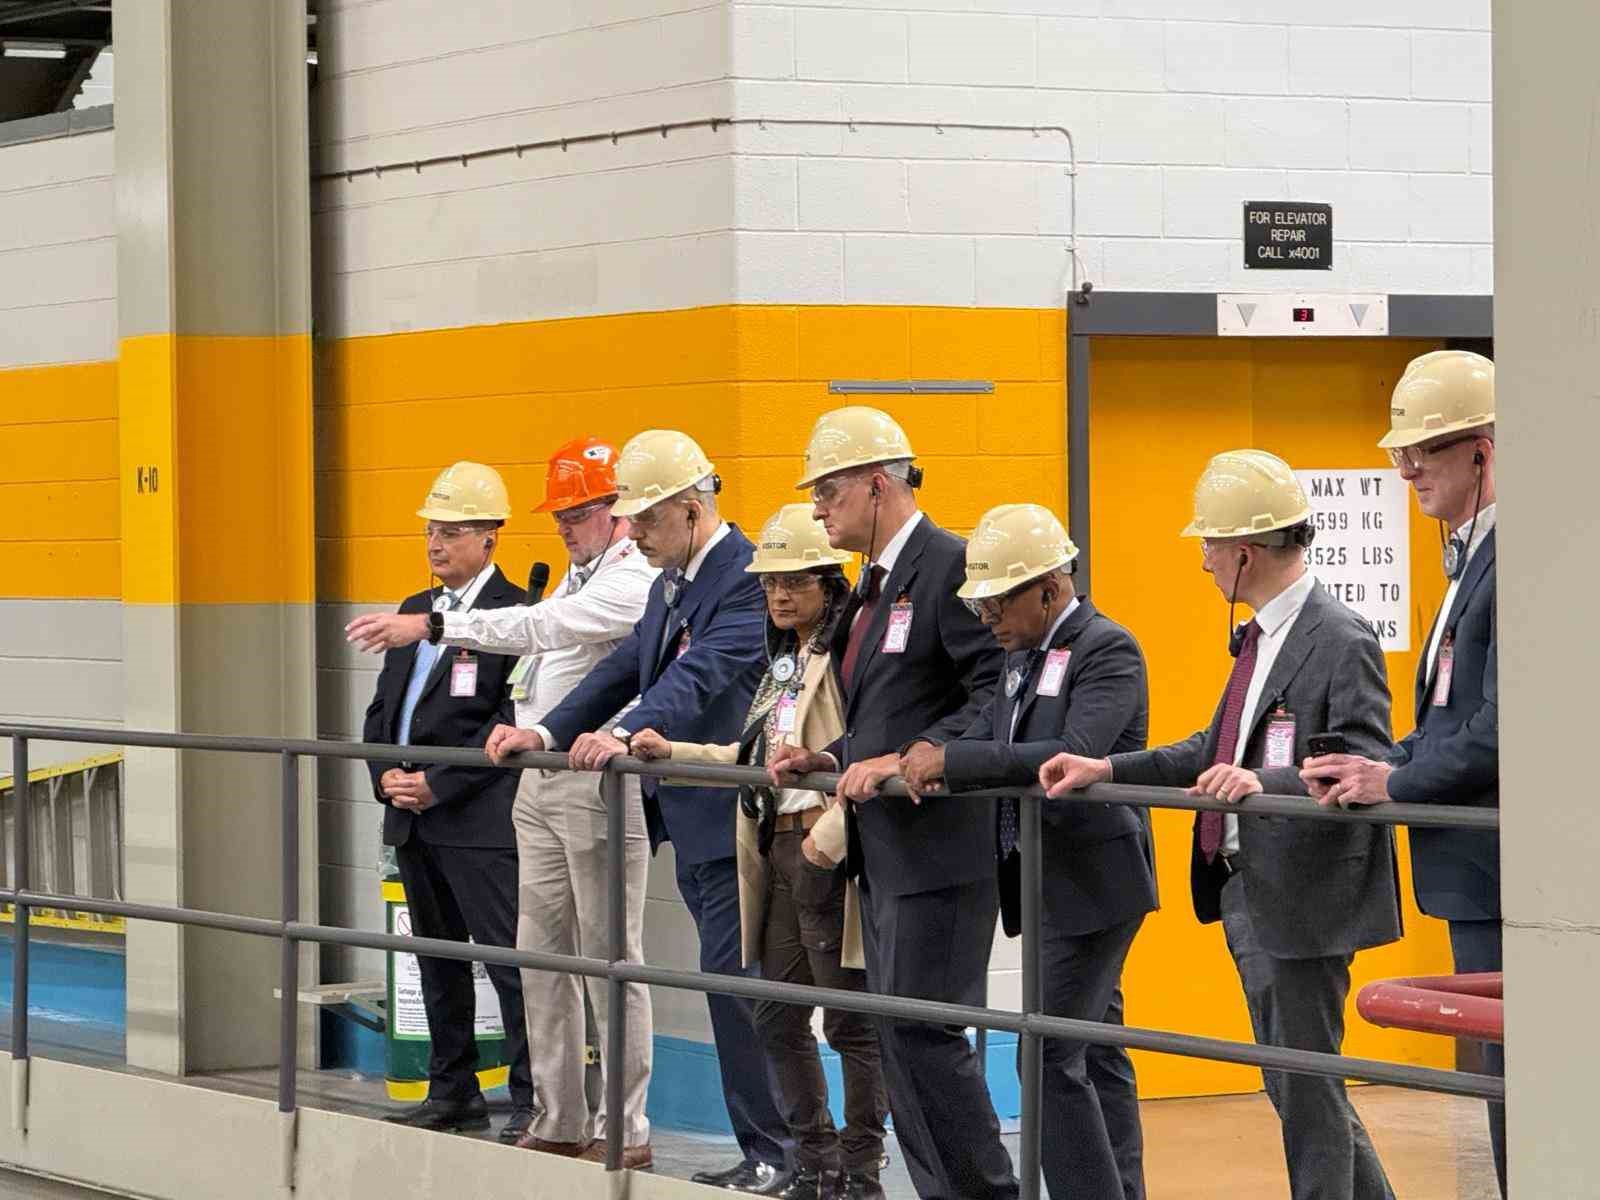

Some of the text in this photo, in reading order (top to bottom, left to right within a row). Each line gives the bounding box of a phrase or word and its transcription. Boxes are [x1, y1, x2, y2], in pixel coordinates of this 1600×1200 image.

[1249, 211, 1327, 225] FOR ELEVATOR
[1270, 229, 1306, 242] REPAIR
[1257, 245, 1320, 259] CALL x4001
[1300, 310, 1308, 321] 3
[1311, 477, 1382, 497] MAX WT
[1362, 512, 1383, 530] KG
[1362, 546, 1394, 565] LBS
[1379, 583, 1400, 602] TO
[1369, 620, 1397, 638] NS
